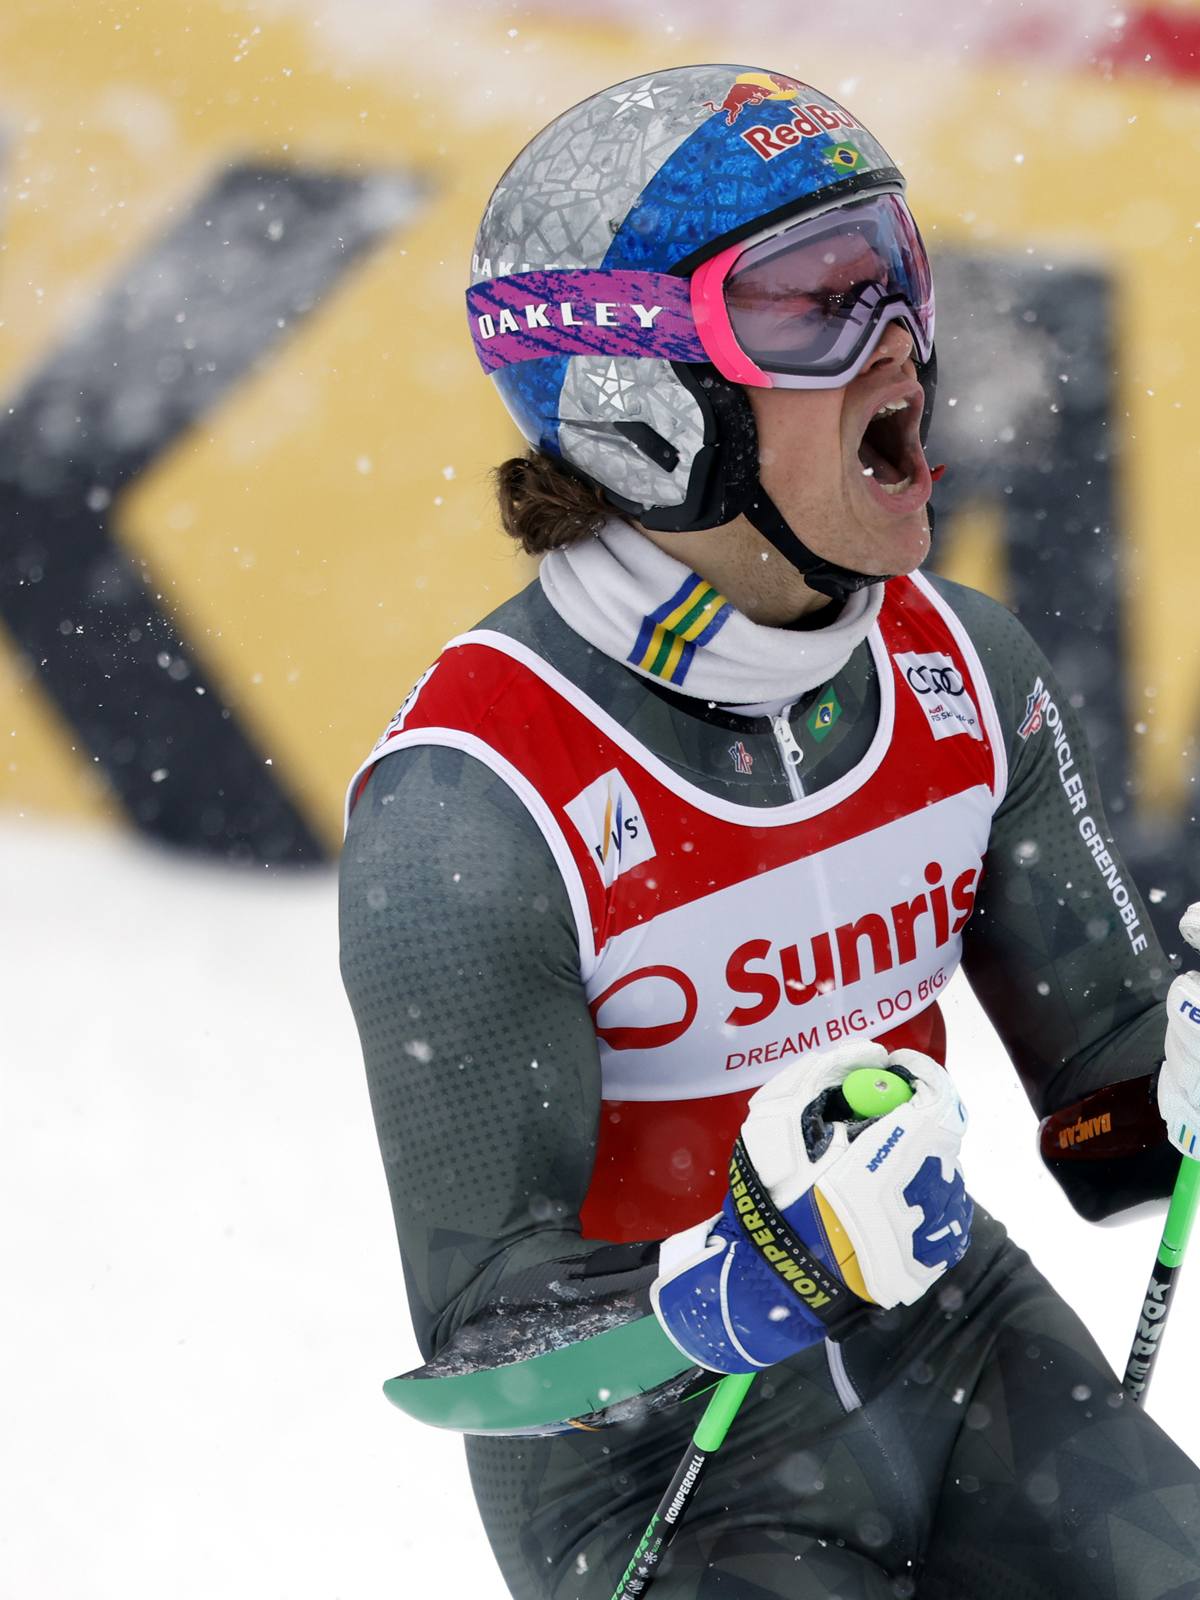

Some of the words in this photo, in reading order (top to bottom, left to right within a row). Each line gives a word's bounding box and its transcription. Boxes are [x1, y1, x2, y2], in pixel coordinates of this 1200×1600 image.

[742, 106, 824, 161] Red
[805, 104, 861, 130] Bul
[478, 302, 662, 340] OAKLEY
[1078, 816, 1148, 956] GRENOBLE
[725, 1027, 821, 1071] DREAM
[826, 1009, 875, 1042] BIG.
[877, 990, 912, 1020] DO
[918, 967, 948, 1001] BIG.
[664, 1454, 706, 1525] KOMPERDELL
